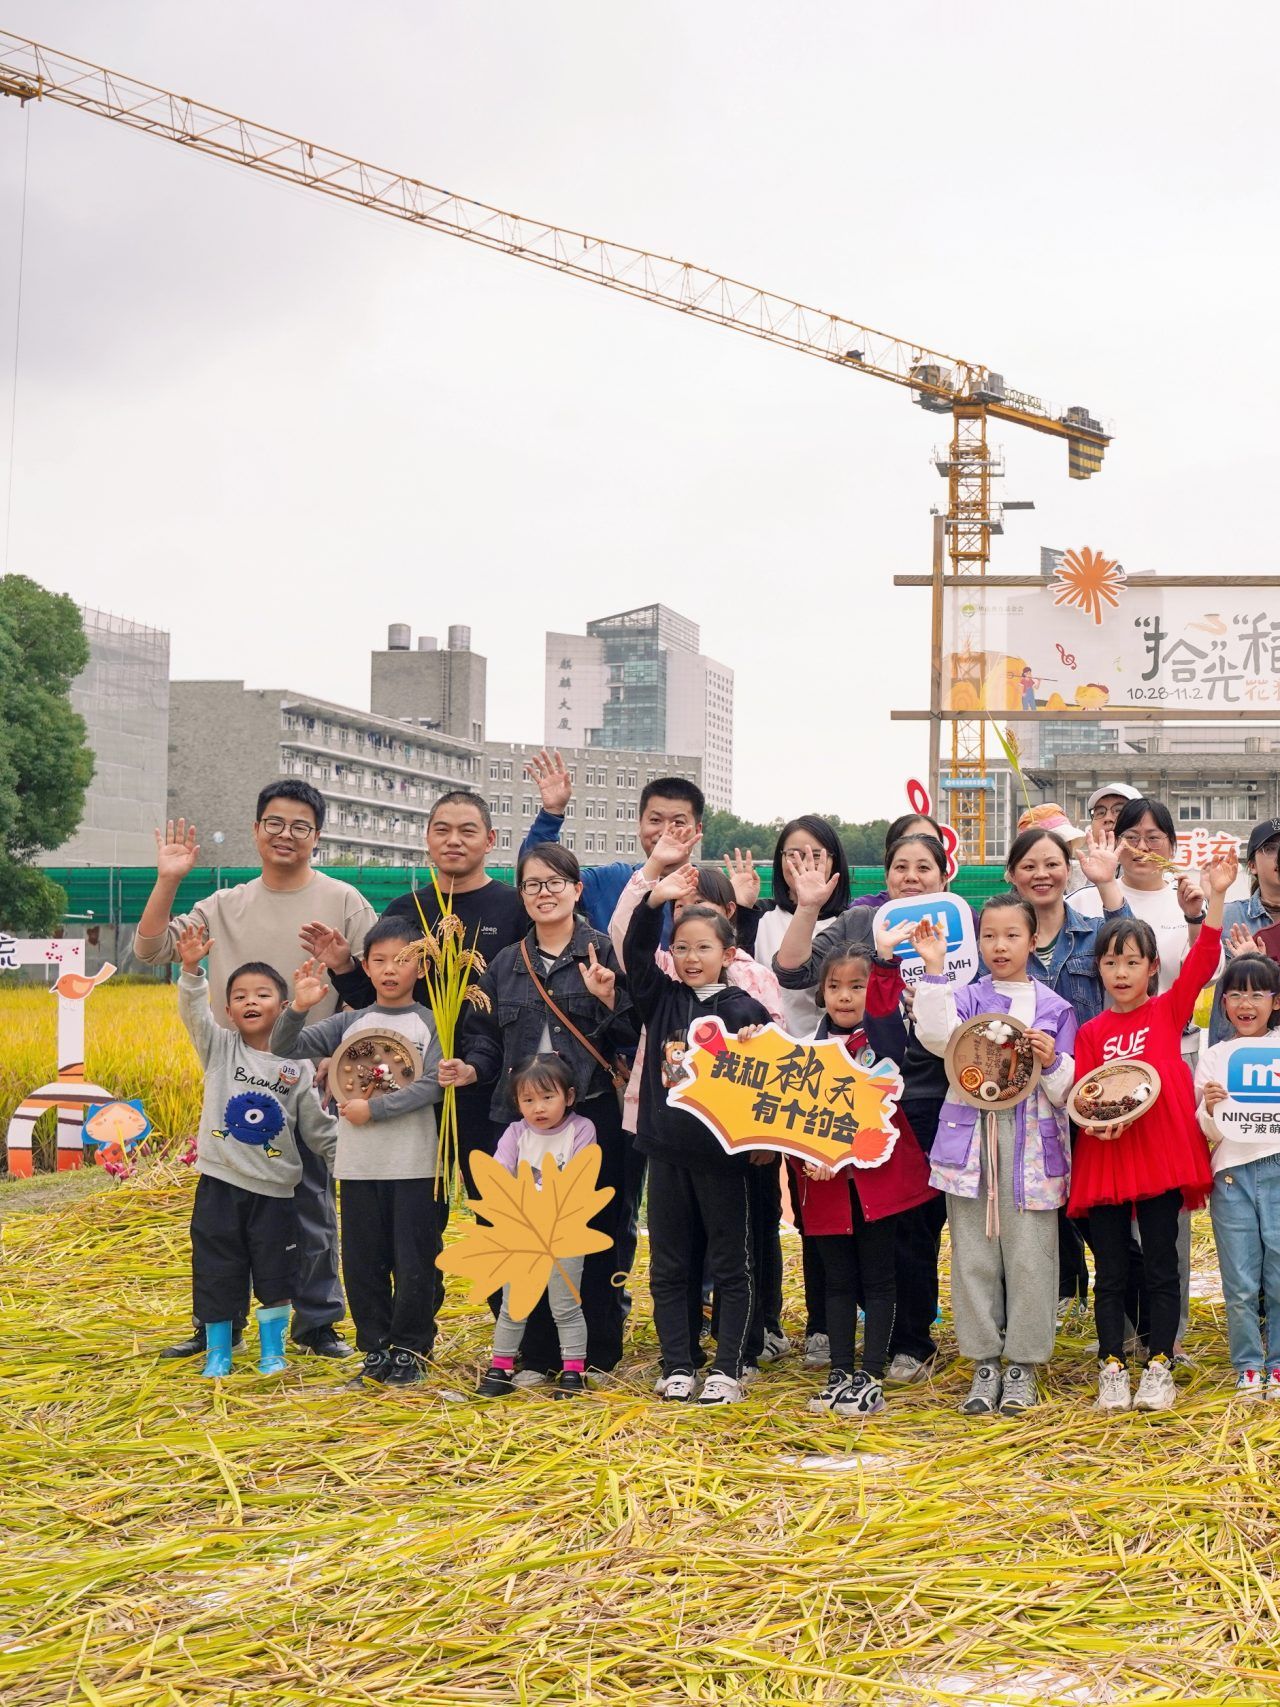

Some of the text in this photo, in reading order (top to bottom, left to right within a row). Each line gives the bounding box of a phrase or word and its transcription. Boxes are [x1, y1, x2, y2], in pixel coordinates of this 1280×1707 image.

[1127, 686, 1204, 701] 10.28-11.2
[481, 925, 498, 933] Jeep
[1103, 1026, 1150, 1060] SUE
[233, 1066, 290, 1096] Brandon
[710, 1044, 856, 1110] 我和秋天
[751, 1091, 860, 1145] 有个约会
